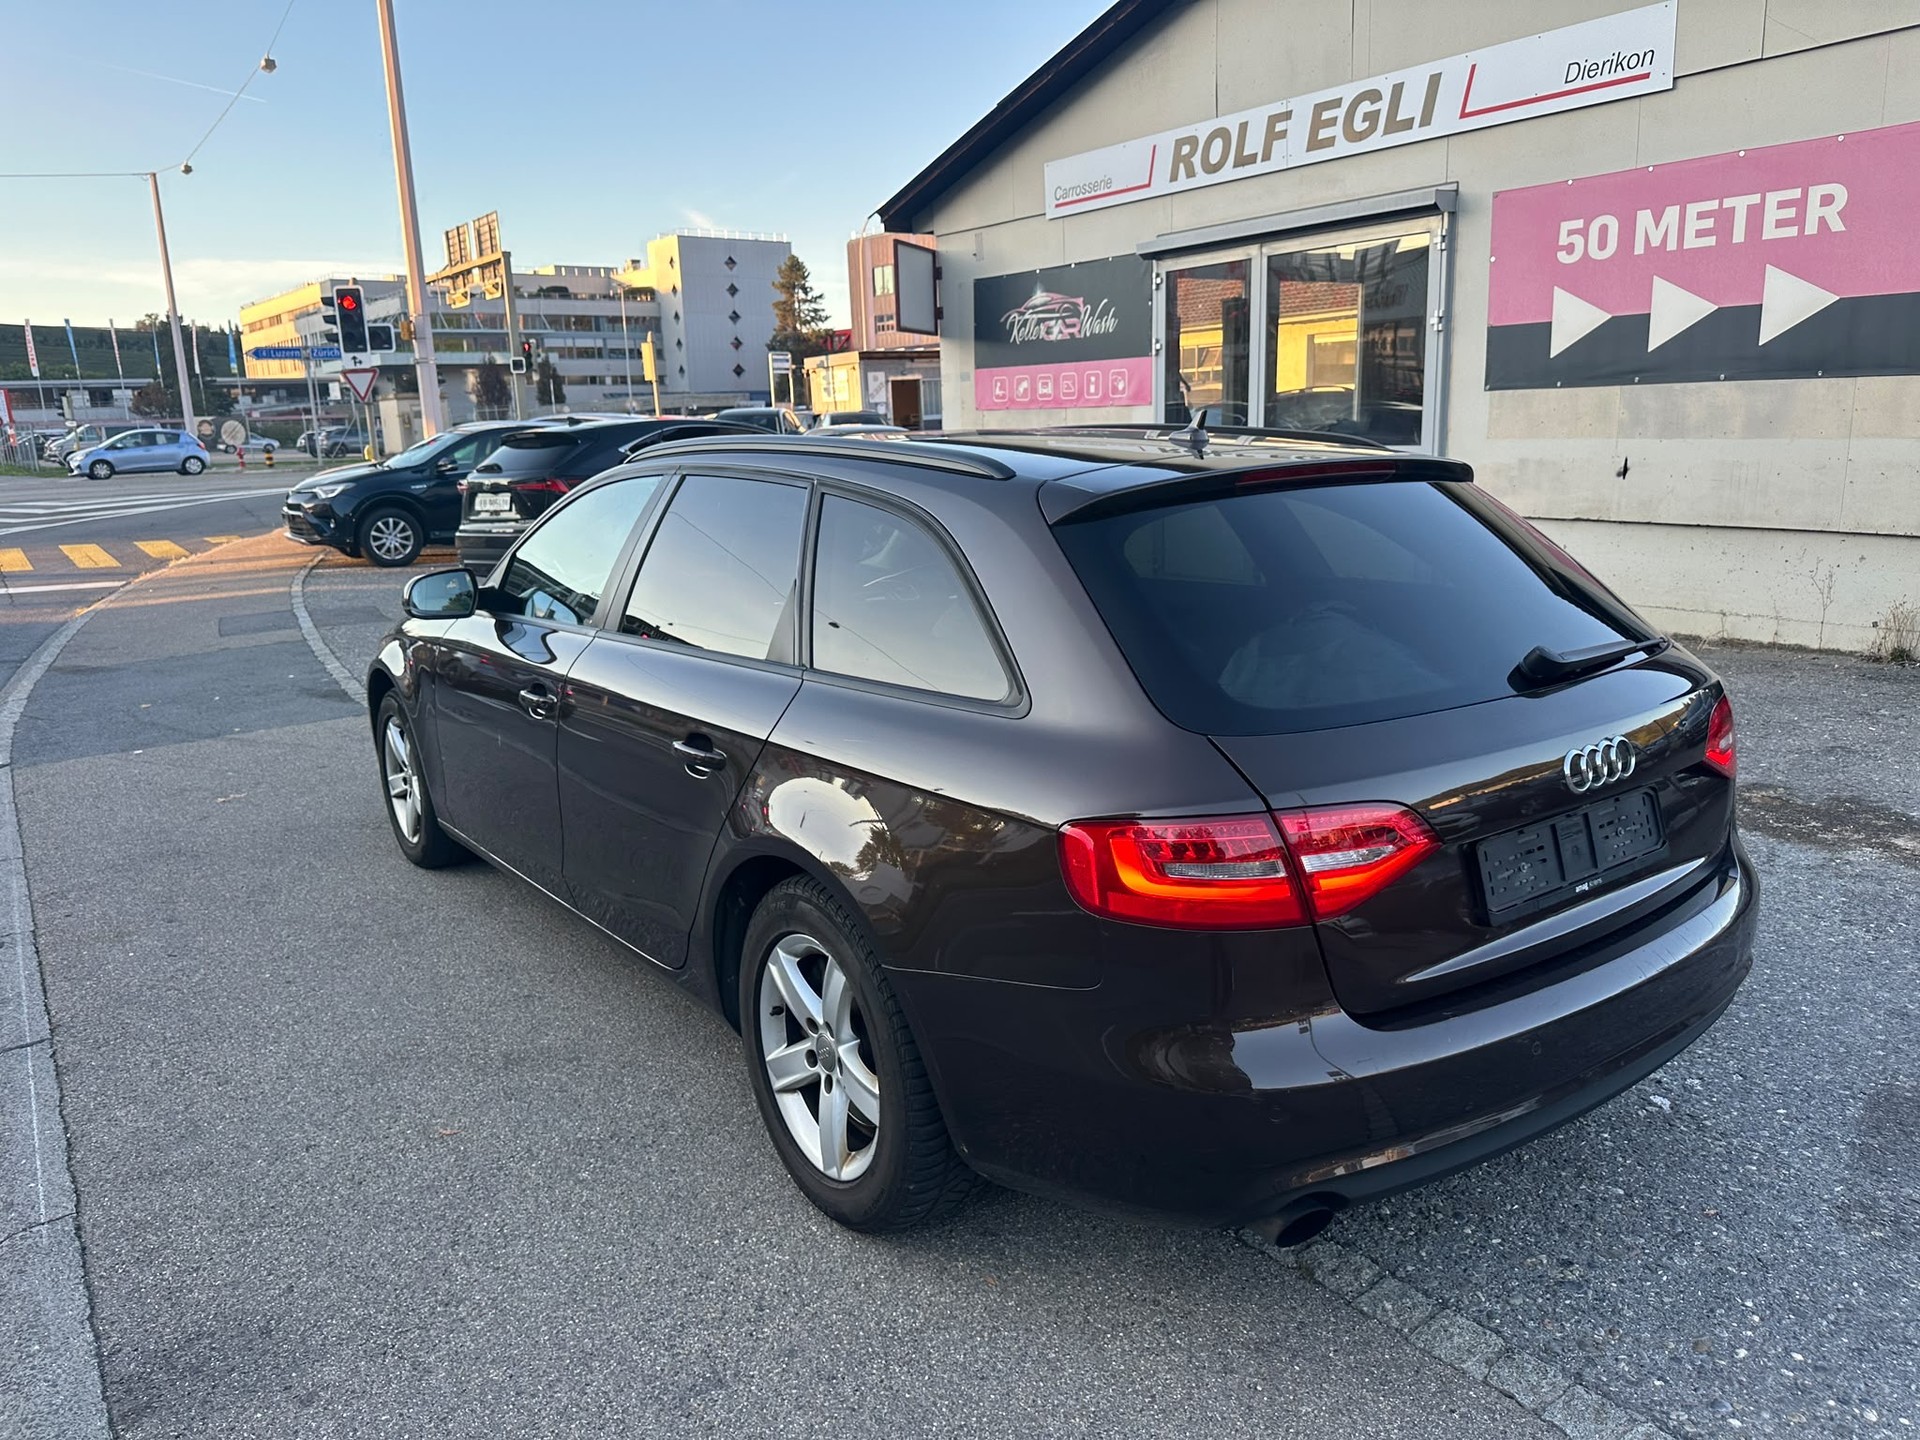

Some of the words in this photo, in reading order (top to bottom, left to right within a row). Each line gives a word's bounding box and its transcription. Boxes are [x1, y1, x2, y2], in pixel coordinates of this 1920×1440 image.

[1564, 49, 1655, 84] Dierikon
[1169, 109, 1293, 183] ROLF
[1306, 71, 1443, 153] EGLI
[1054, 175, 1113, 201] Carrosserie
[1556, 213, 1619, 264] 50
[1633, 183, 1848, 256] METER
[1006, 309, 1047, 344] Keller
[1080, 298, 1118, 338] Wash
[270, 348, 300, 358] Luzern
[313, 347, 340, 358] Zürich
